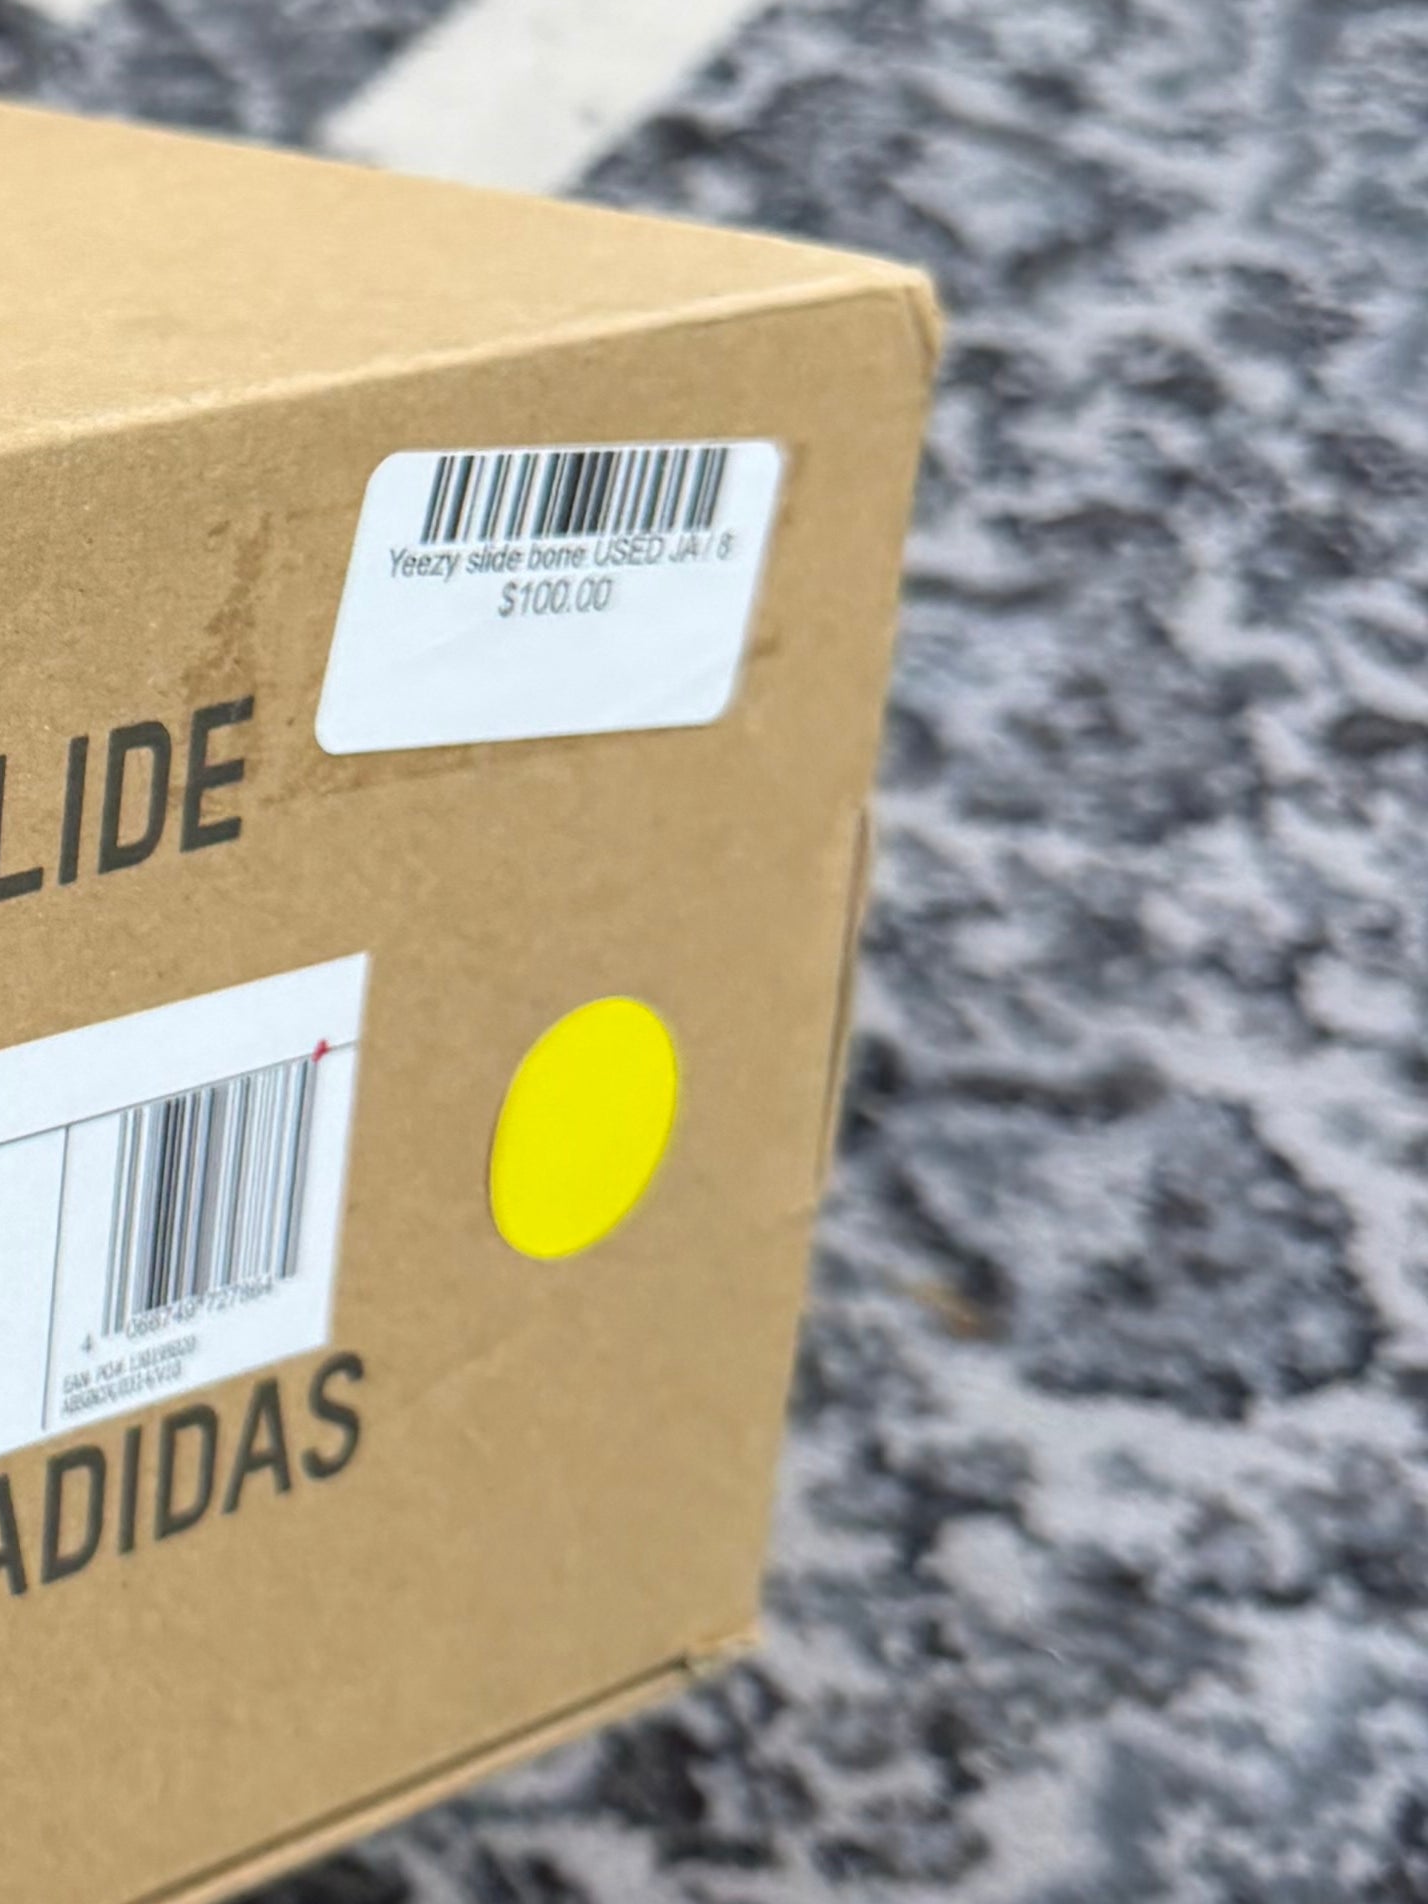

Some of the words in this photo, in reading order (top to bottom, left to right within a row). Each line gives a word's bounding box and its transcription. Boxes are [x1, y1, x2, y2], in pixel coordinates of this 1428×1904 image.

[389, 548, 459, 583] Yeezy
[466, 543, 522, 574] slide
[527, 542, 585, 571] bone
[594, 535, 663, 567] USED
[497, 577, 614, 618] $100.00
